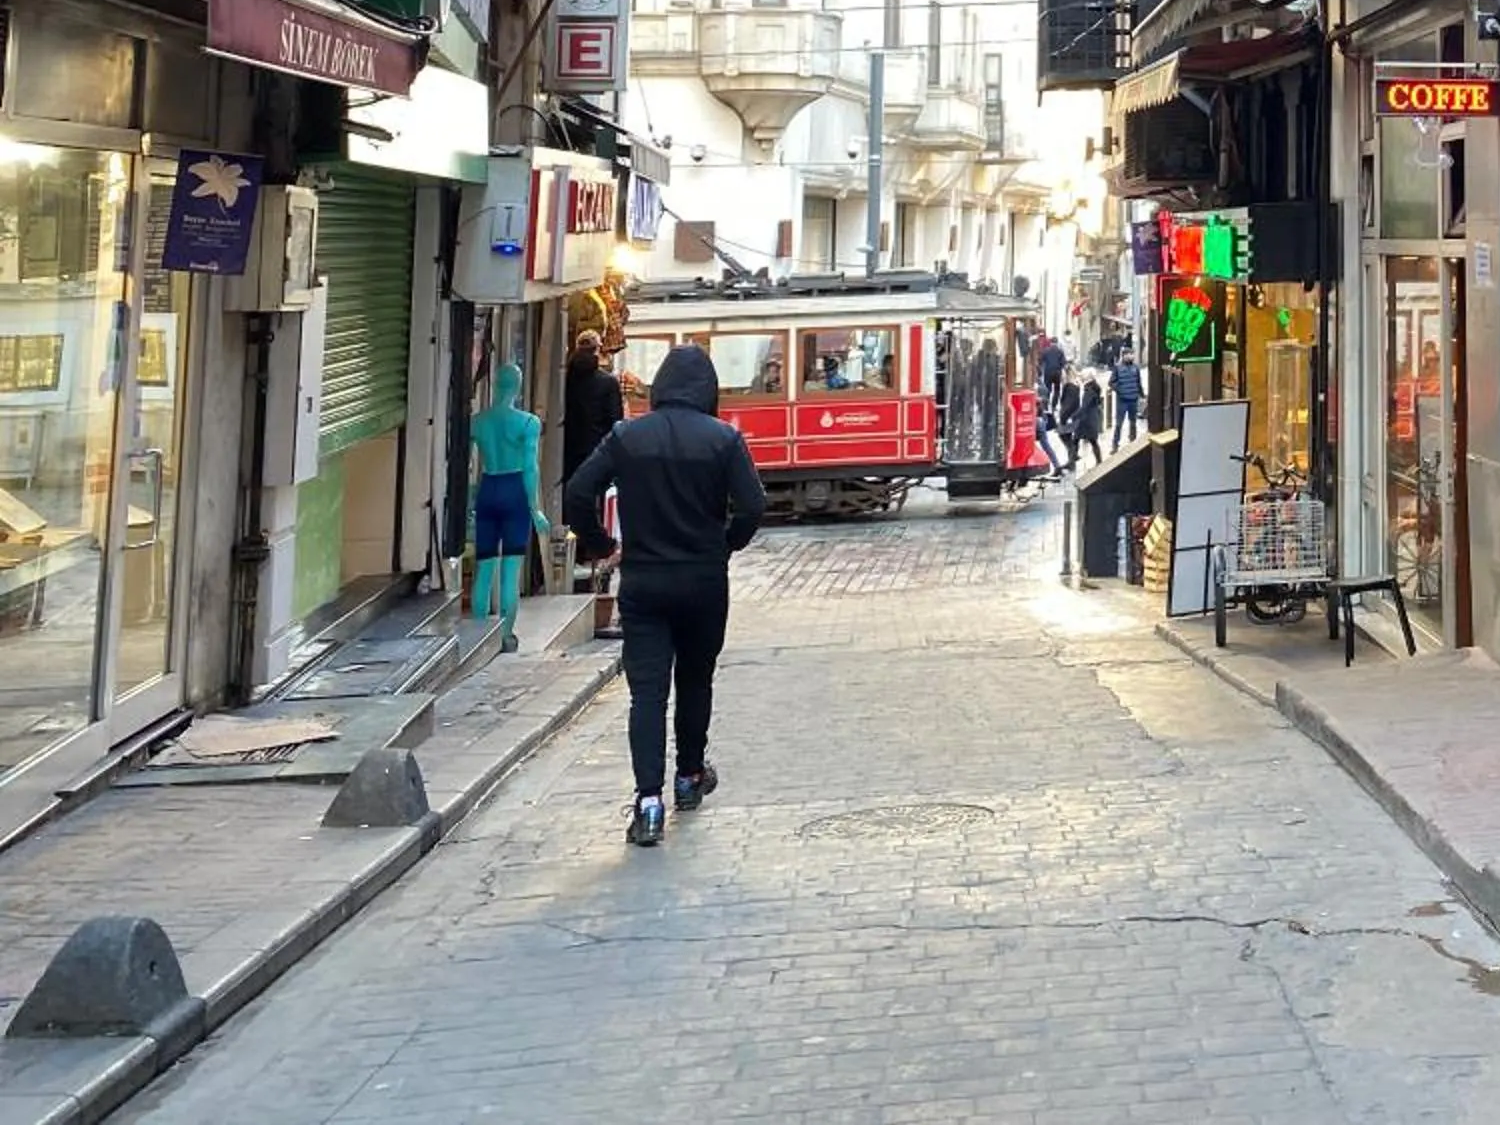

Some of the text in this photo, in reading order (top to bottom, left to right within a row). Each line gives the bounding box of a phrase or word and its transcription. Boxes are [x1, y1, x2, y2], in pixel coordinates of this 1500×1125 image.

[280, 11, 331, 73] SİNEM
[570, 33, 601, 70] E
[1388, 83, 1490, 111] COFFE
